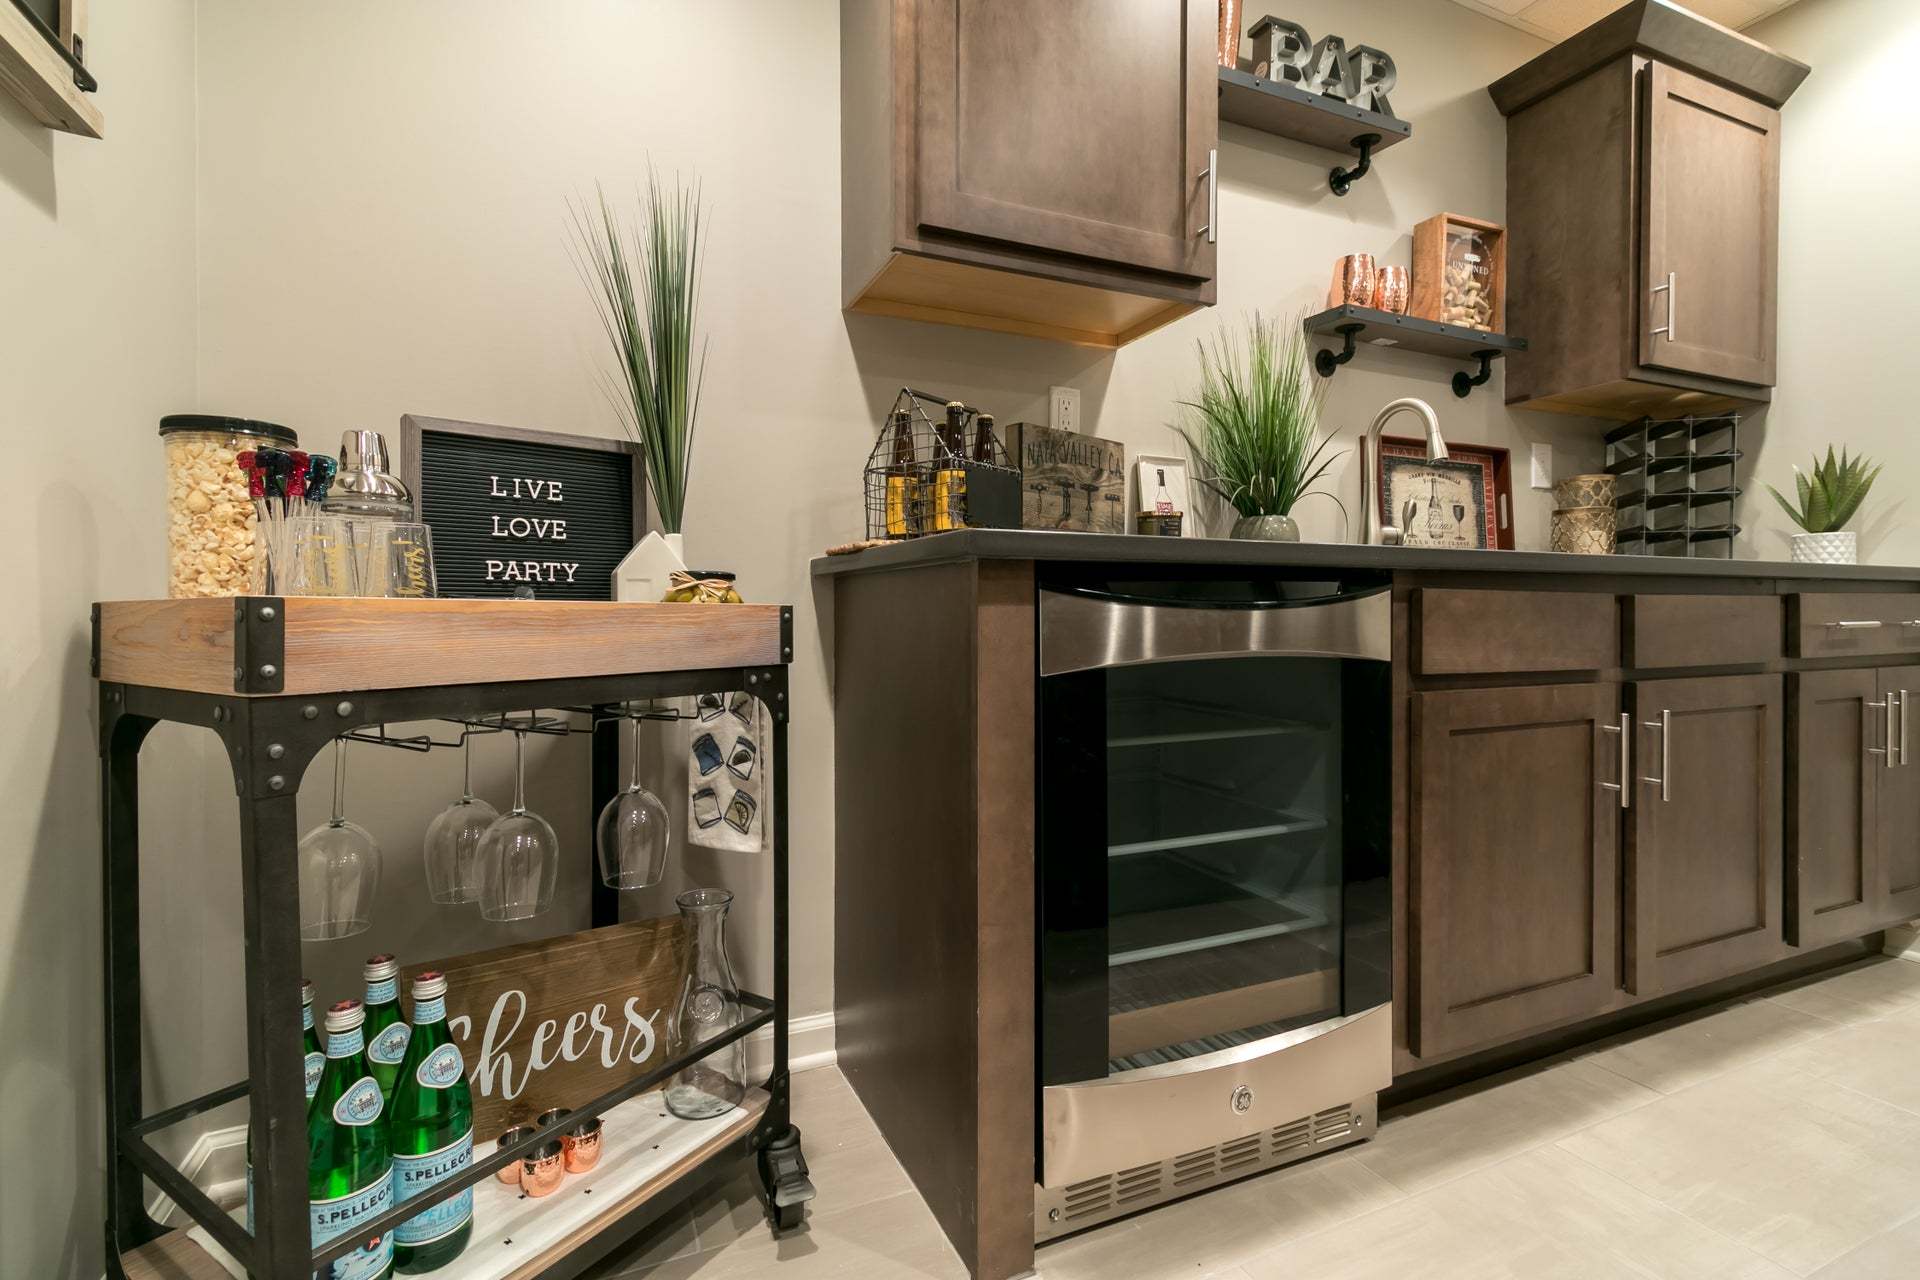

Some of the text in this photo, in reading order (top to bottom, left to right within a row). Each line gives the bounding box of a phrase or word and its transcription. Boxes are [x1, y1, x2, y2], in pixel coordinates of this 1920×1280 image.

[1248, 15, 1397, 118] BAR
[1452, 260, 1489, 275] UNNED
[1028, 440, 1123, 476] NAPA VALLEY CA
[490, 476, 563, 501] LIVE
[492, 515, 567, 539] LOVE
[485, 560, 579, 582] PARTY
